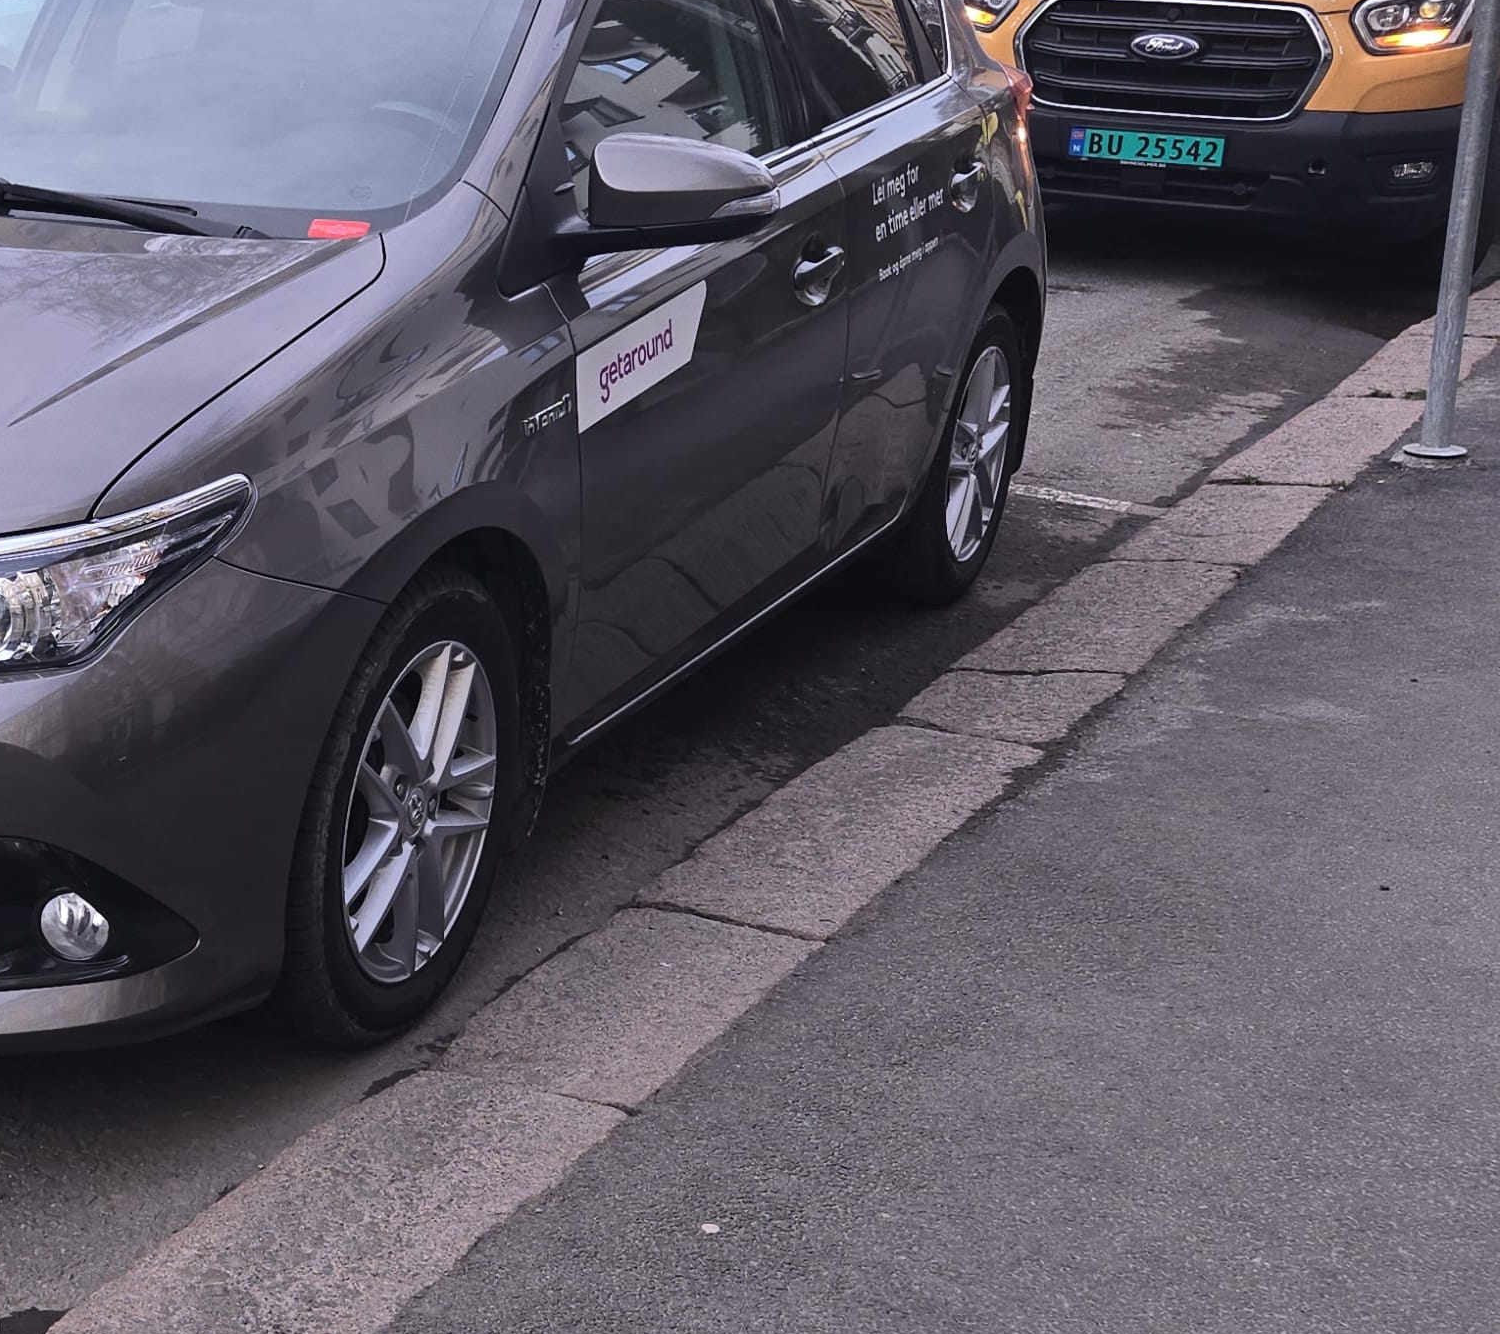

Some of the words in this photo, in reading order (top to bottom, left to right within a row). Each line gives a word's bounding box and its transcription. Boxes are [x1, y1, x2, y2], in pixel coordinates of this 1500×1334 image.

[1142, 37, 1183, 53] Ford
[1073, 144, 1080, 152] N
[1089, 133, 1123, 156] BU
[1135, 136, 1218, 164] 25542
[872, 177, 886, 206] Lei
[886, 173, 906, 198] meg
[907, 163, 919, 186] for
[875, 222, 887, 242] en
[888, 209, 909, 234] time
[909, 196, 927, 221] eller
[928, 188, 944, 211] mer
[879, 263, 892, 281] Book
[600, 319, 673, 404] getaround
